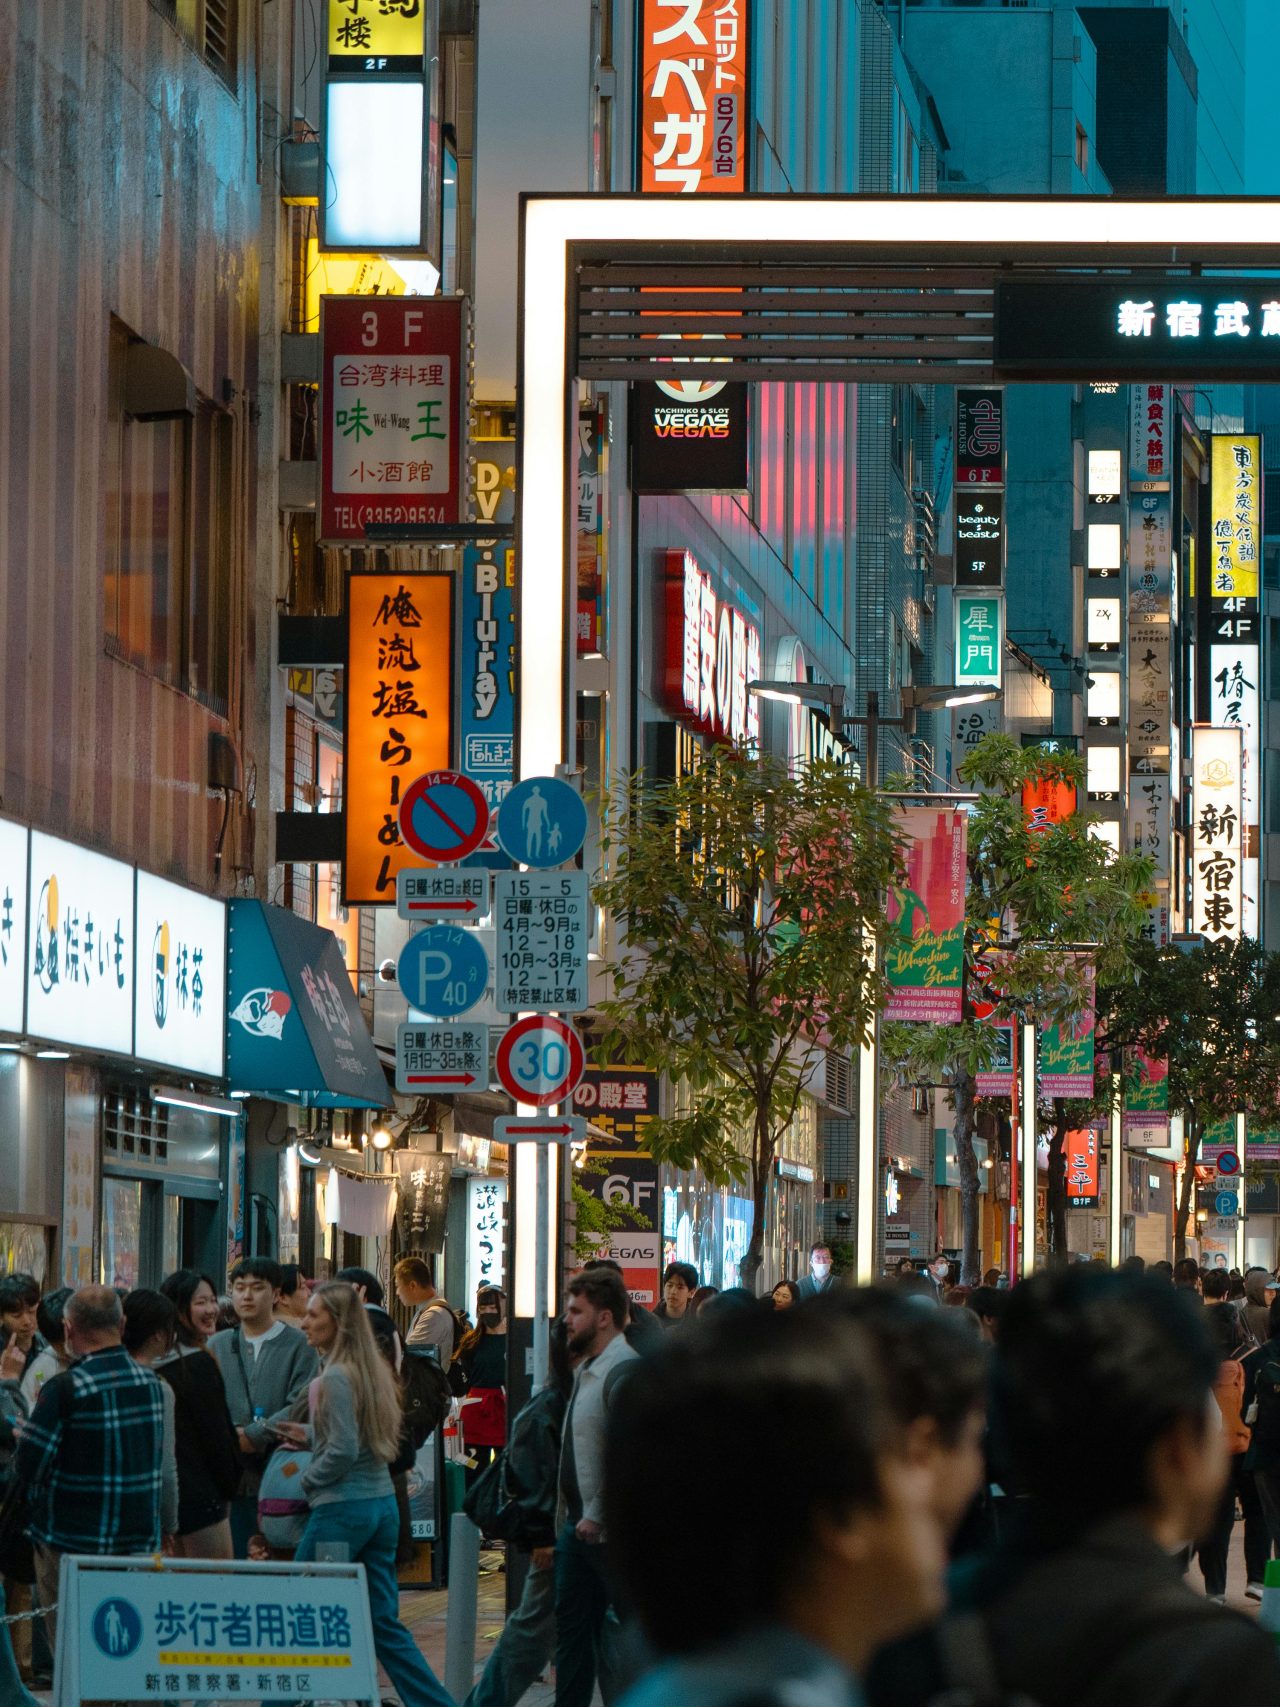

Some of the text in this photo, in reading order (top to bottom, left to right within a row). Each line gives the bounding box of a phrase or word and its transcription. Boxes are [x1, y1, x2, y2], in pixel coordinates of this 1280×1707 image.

[365, 59, 387, 70] 2F
[716, 97, 734, 174] 876台
[339, 364, 446, 387] 台湾料理
[336, 398, 447, 443] 味 Wei-Wang 王
[655, 414, 730, 427] VEGAS
[959, 401, 967, 455] ALE HOUSE
[655, 425, 730, 438] VEGAS
[350, 460, 434, 483] 小酒館
[1143, 498, 1158, 508] 6F
[1233, 445, 1256, 561] 東方炭火伝説
[959, 515, 1000, 525] beauty
[972, 562, 986, 571] 5F
[1100, 569, 1109, 577] 5
[1223, 597, 1246, 612] 4F
[1217, 620, 1251, 637] 4F
[1100, 643, 1109, 651] 4
[1100, 717, 1109, 726] 3
[1144, 723, 1156, 731] 5F
[427, 774, 460, 786] 14-7
[405, 878, 483, 897] 日曜・休日は終日
[506, 900, 578, 915] 日曜・休日の
[422, 930, 463, 946] 7-14
[64, 906, 125, 989] 焼きいも
[418, 951, 452, 1006] P
[442, 981, 467, 1005] 40
[503, 987, 582, 1004] (特定禁止区域)
[404, 1032, 482, 1050] 日曜・休日を除く
[517, 1041, 566, 1082] 30
[154, 1601, 353, 1648] 歩行者用道路
[145, 1673, 312, 1693] 新宿警察署・新宿区
